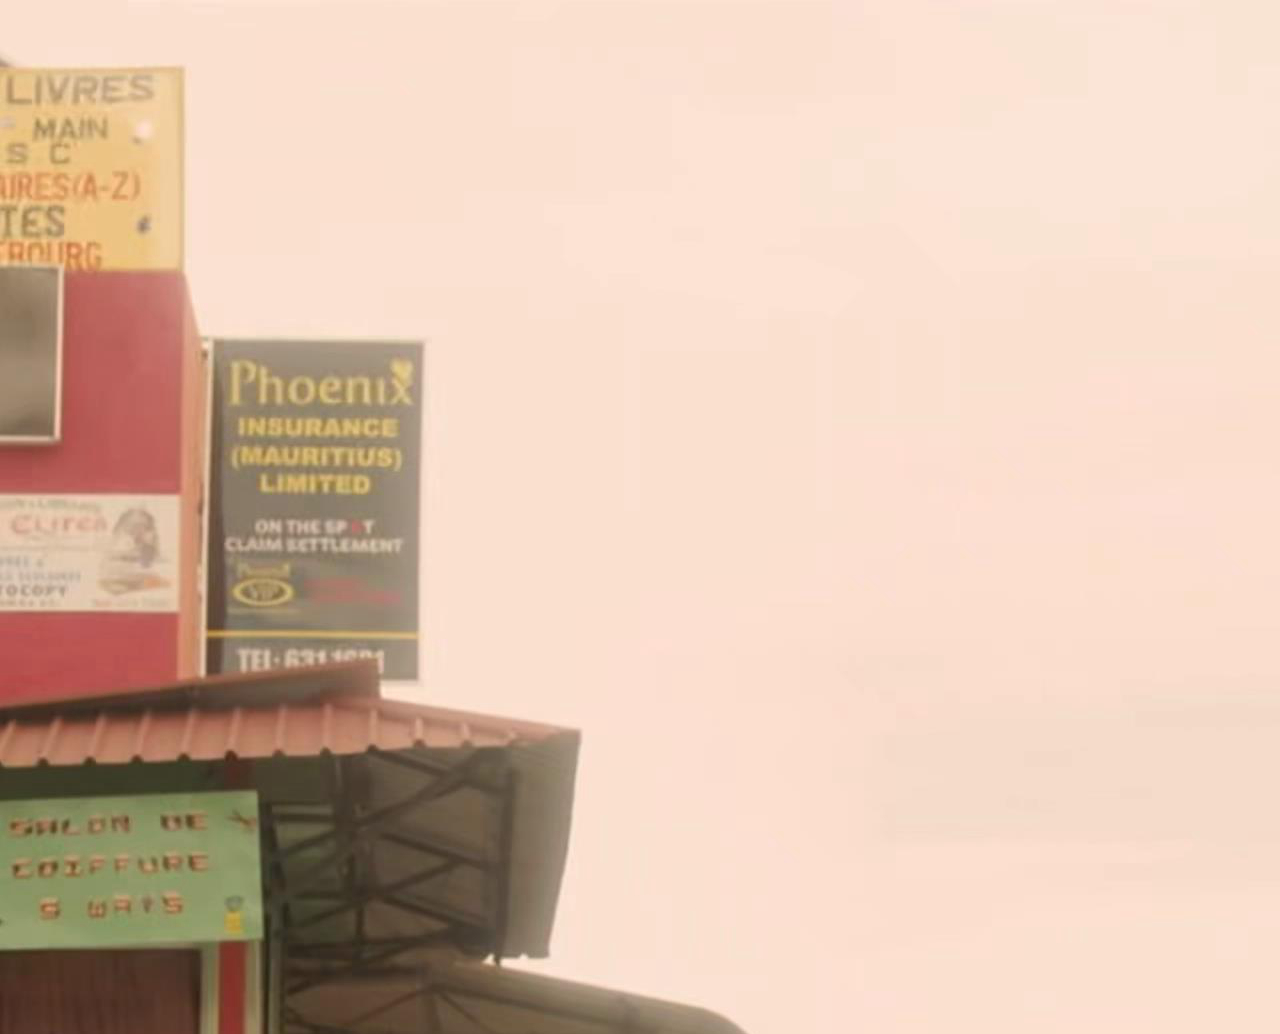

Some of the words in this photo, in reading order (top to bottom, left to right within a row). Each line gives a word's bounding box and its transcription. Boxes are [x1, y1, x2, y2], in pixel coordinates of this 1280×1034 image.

[5, 74, 154, 106] LIVRES
[32, 117, 109, 141] MAIN
[229, 358, 414, 406] Phoenix
[237, 417, 400, 438] INSURANCE
[231, 445, 403, 472] (MAURITIUS)
[260, 473, 371, 495] LIMITED
[255, 518, 283, 535] ON
[287, 518, 321, 535] THE
[224, 536, 283, 552] CLAIM
[286, 537, 404, 553] SETTLEMENT
[8, 812, 131, 838] SALON
[161, 810, 208, 831] DE
[11, 853, 208, 880] COIFFURE
